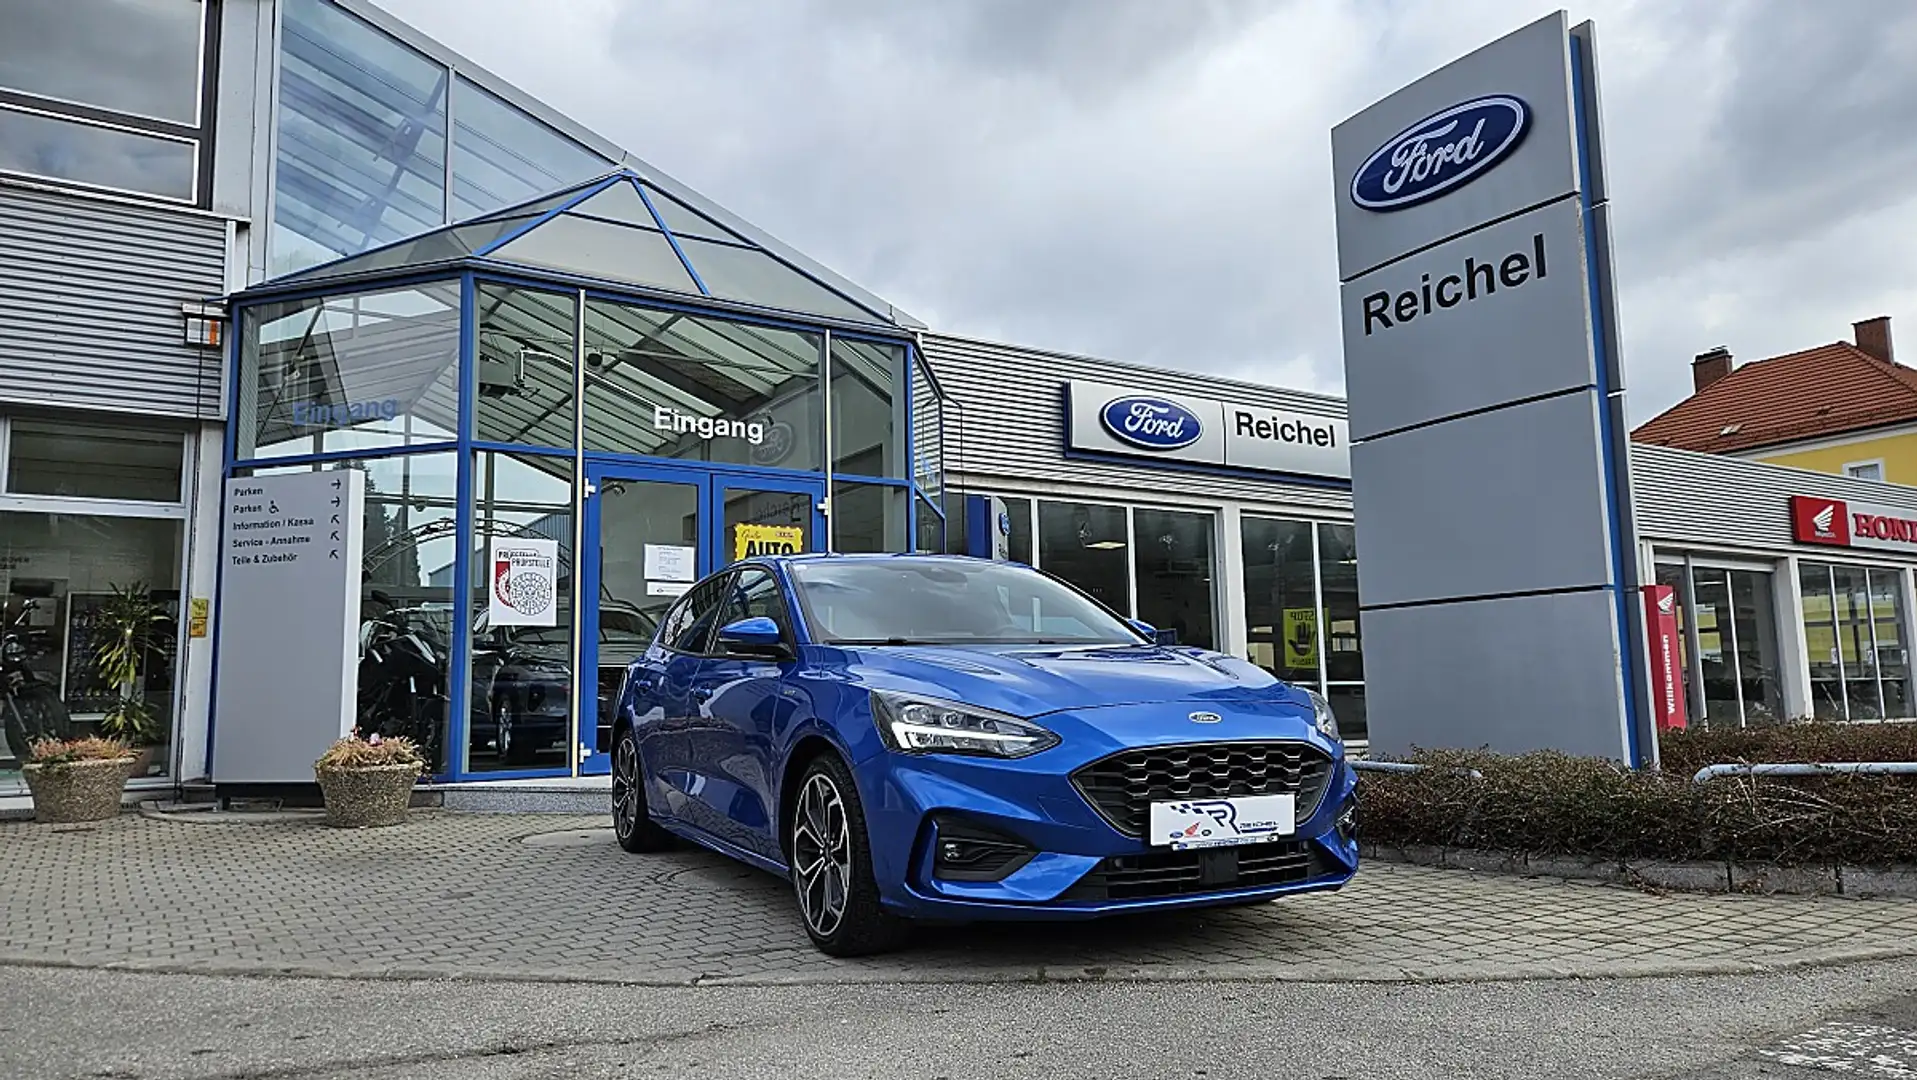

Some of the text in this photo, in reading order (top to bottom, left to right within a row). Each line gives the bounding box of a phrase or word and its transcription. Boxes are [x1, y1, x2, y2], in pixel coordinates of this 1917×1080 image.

[1383, 118, 1486, 194] Ford
[1362, 233, 1547, 336] Reichel
[293, 399, 397, 427] Eingang
[653, 405, 764, 445] Eingang
[1124, 402, 1336, 448] Ford Reichel
[234, 487, 263, 496] Parken
[233, 505, 262, 514] Parken
[232, 519, 281, 531] Information
[232, 538, 263, 548] Service
[270, 536, 311, 546] Annahme
[745, 540, 794, 558] AUTO
[232, 552, 298, 566] Teile & Zubehör
[1662, 634, 1676, 714] Willkommen
